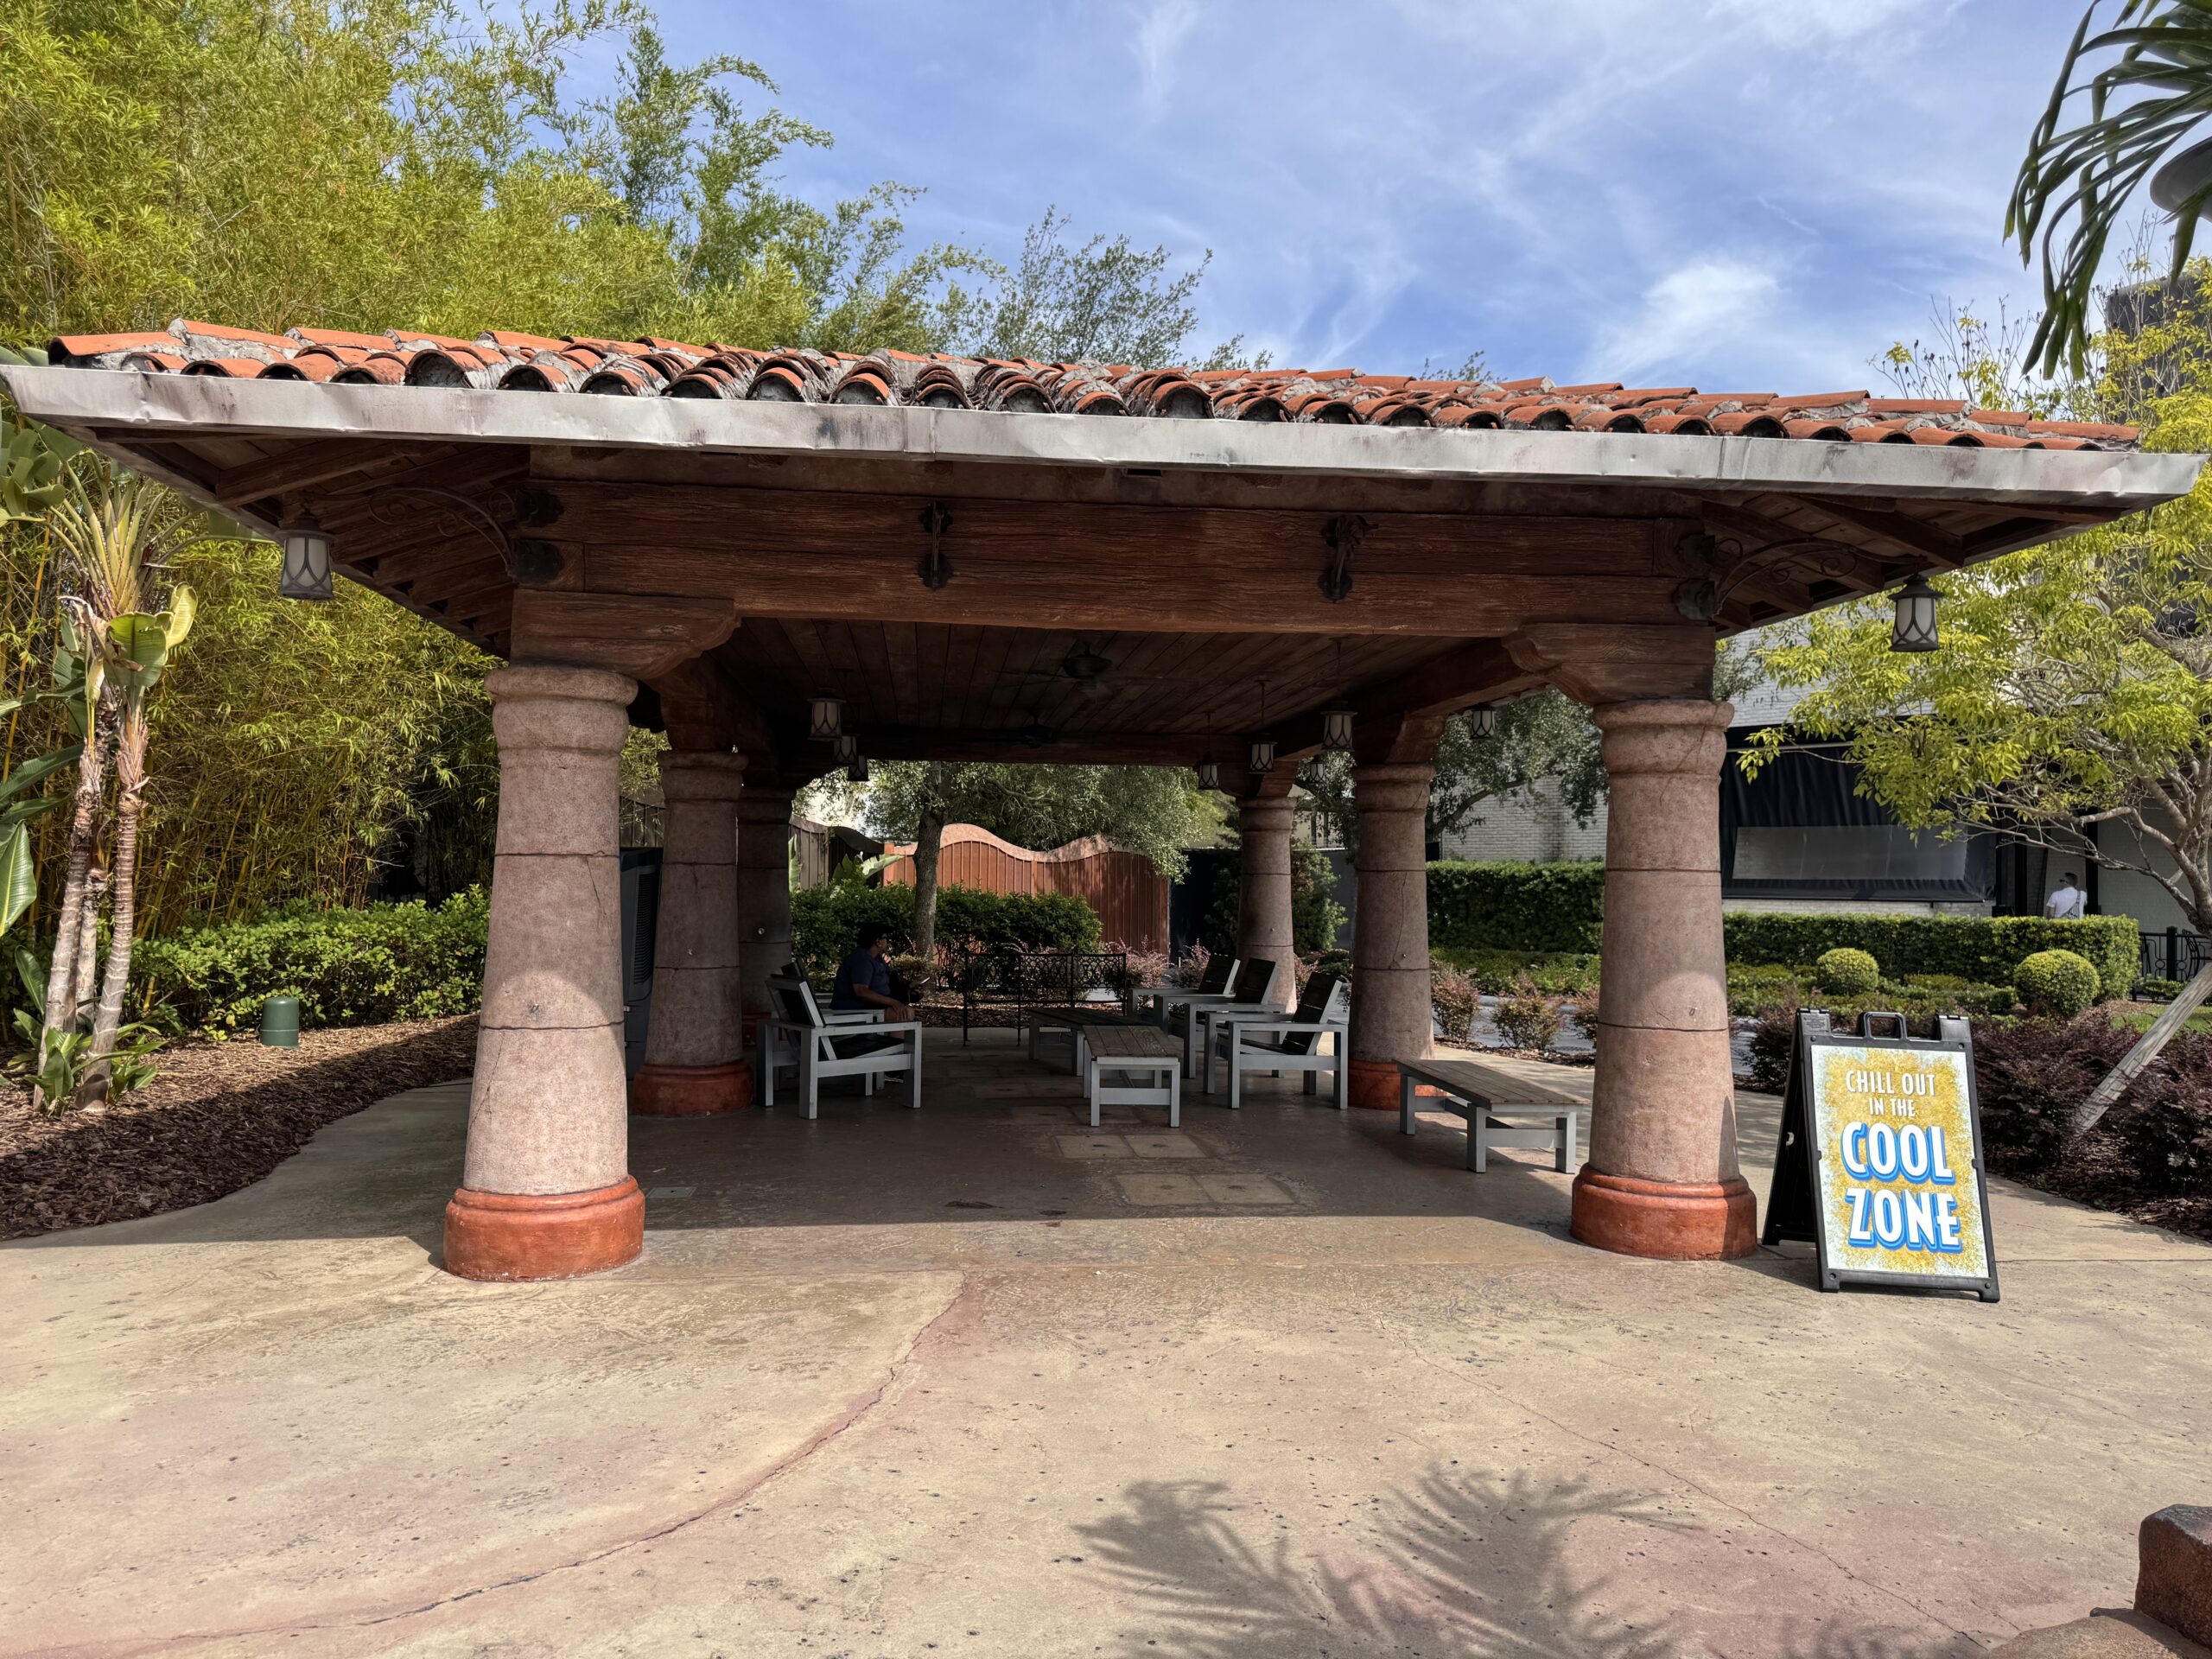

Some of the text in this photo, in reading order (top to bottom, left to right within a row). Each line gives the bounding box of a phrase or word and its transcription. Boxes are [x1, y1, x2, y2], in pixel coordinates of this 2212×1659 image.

[1846, 1071, 1936, 1096] CHILL OUT
[1869, 1097, 1916, 1117] IN THE
[1840, 1122, 1955, 1185] COOL
[1845, 1187, 1962, 1253] ZONE
